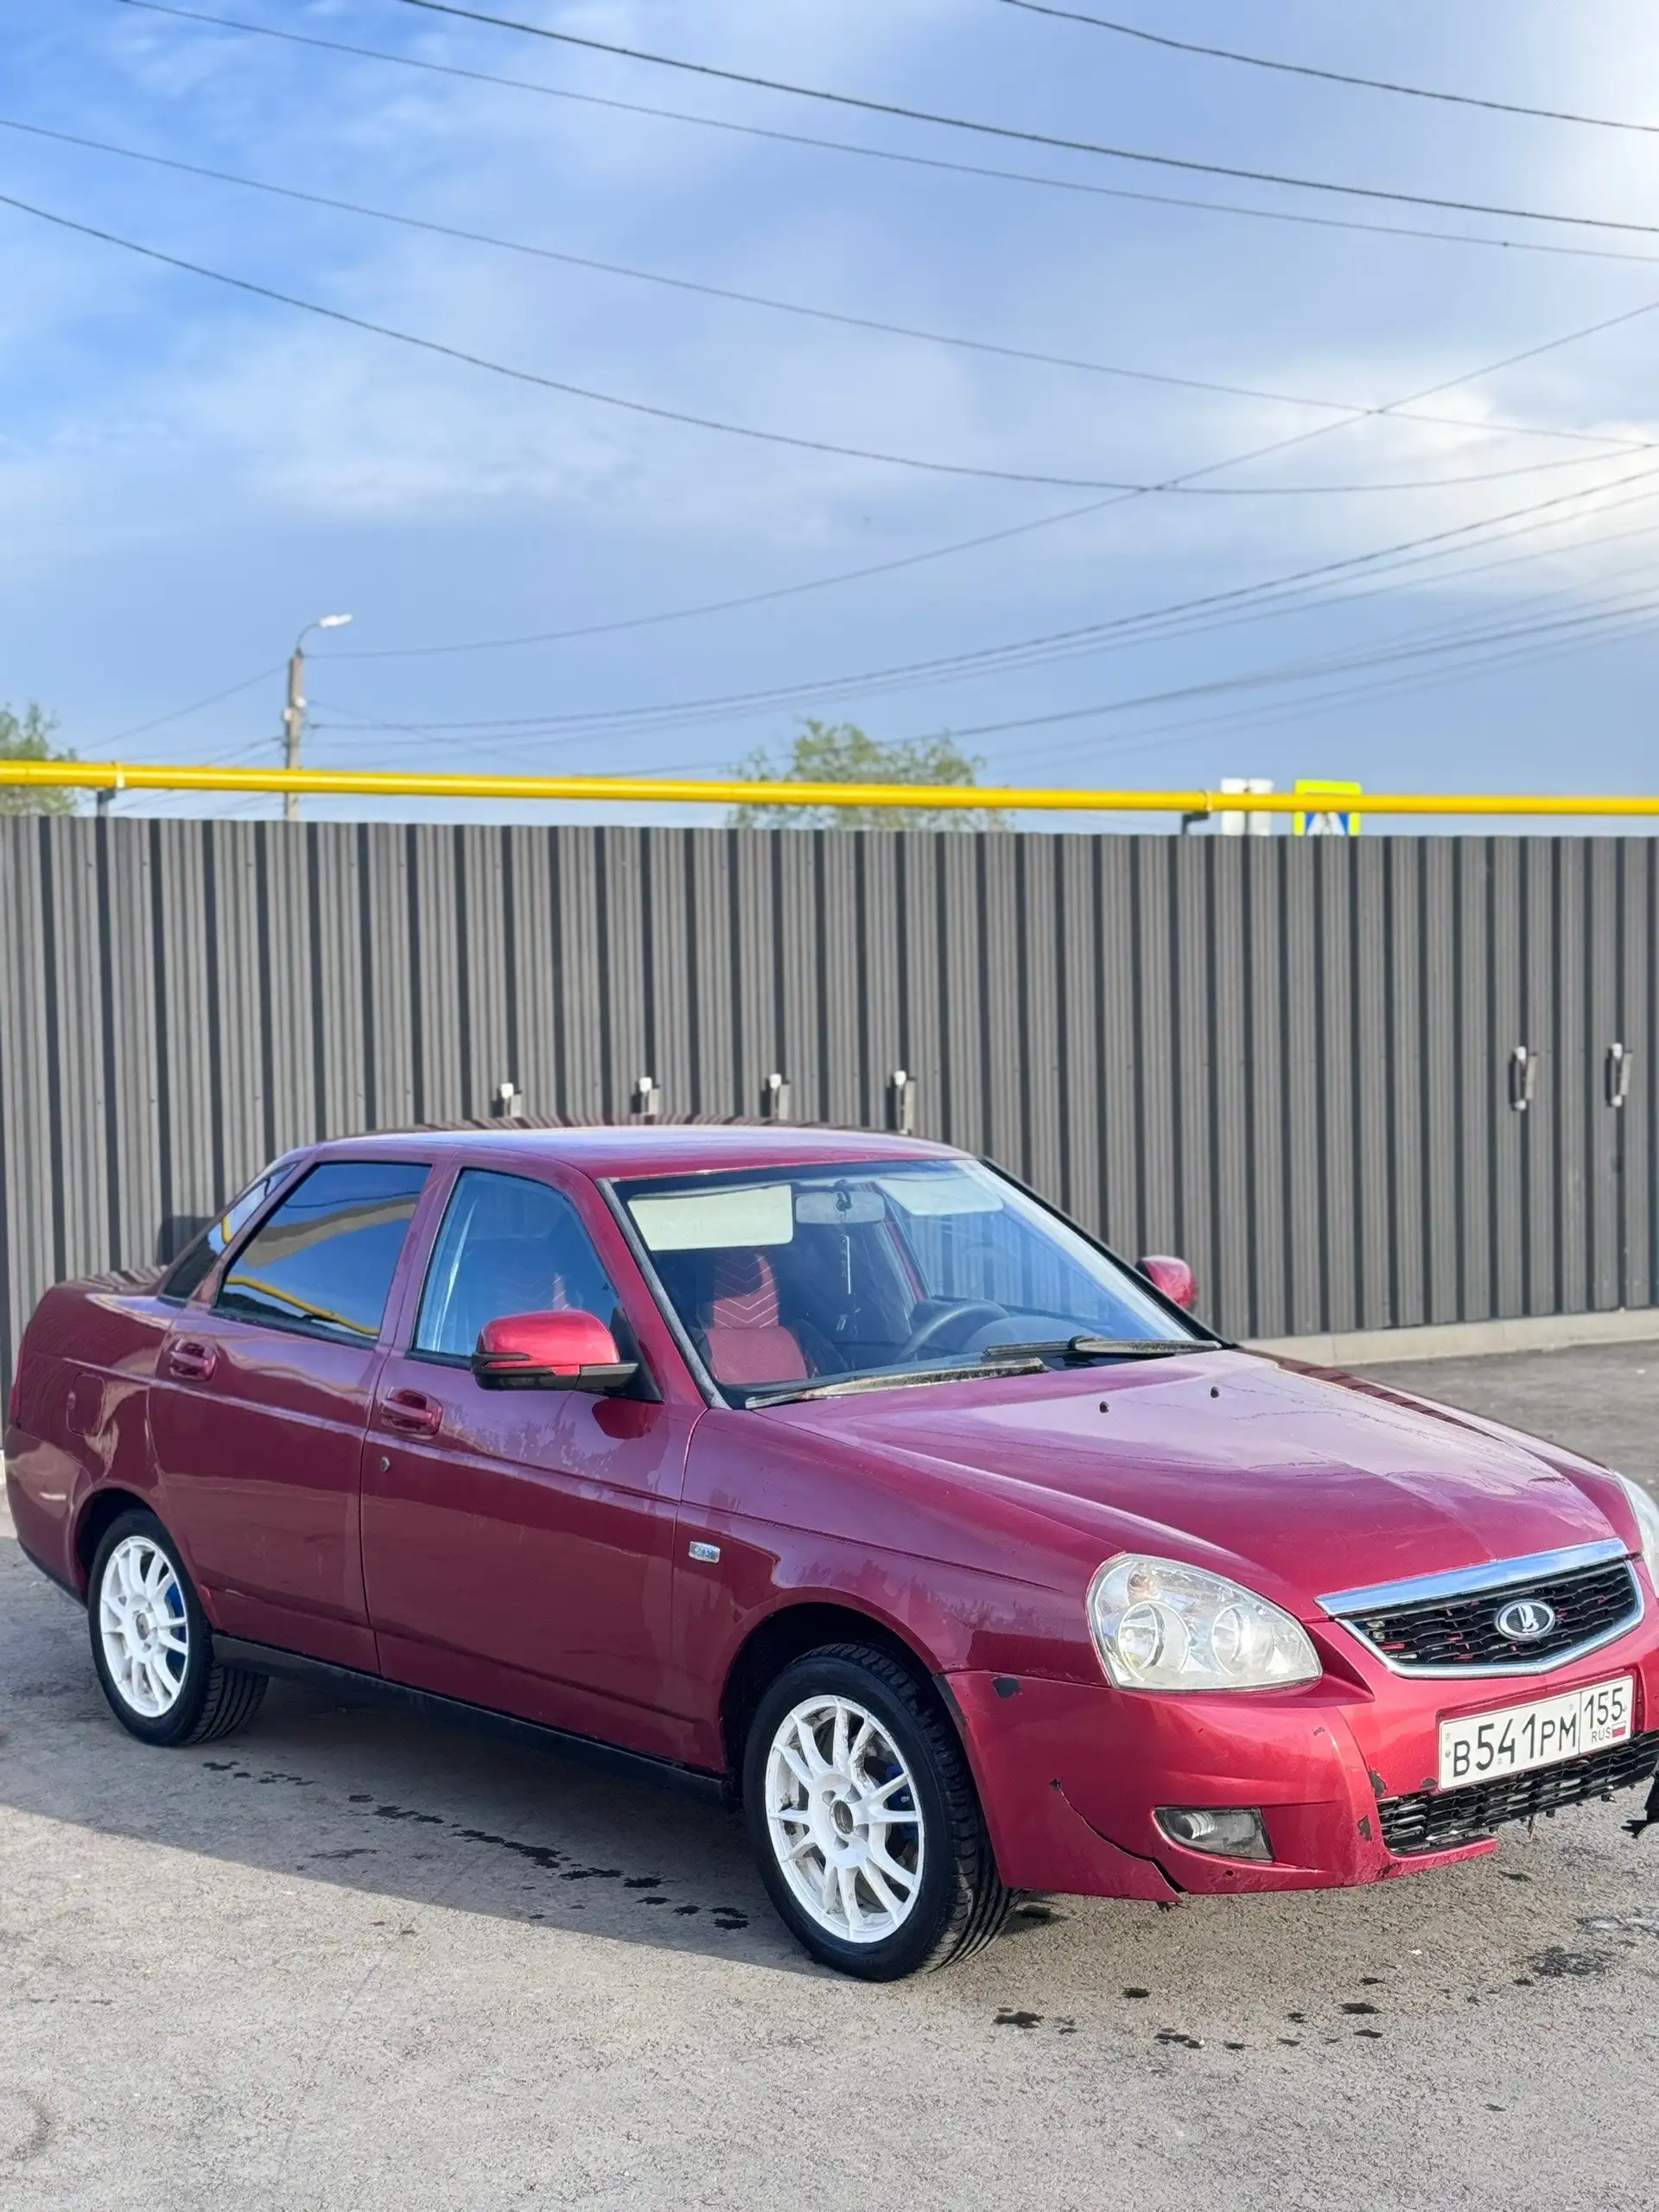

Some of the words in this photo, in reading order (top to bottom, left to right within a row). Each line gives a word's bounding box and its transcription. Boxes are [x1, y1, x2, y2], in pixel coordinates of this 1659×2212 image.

[1453, 1713, 1577, 1777] В541РМ
[1584, 1687, 1624, 1729] 155
[1591, 1726, 1611, 1744] RUS
